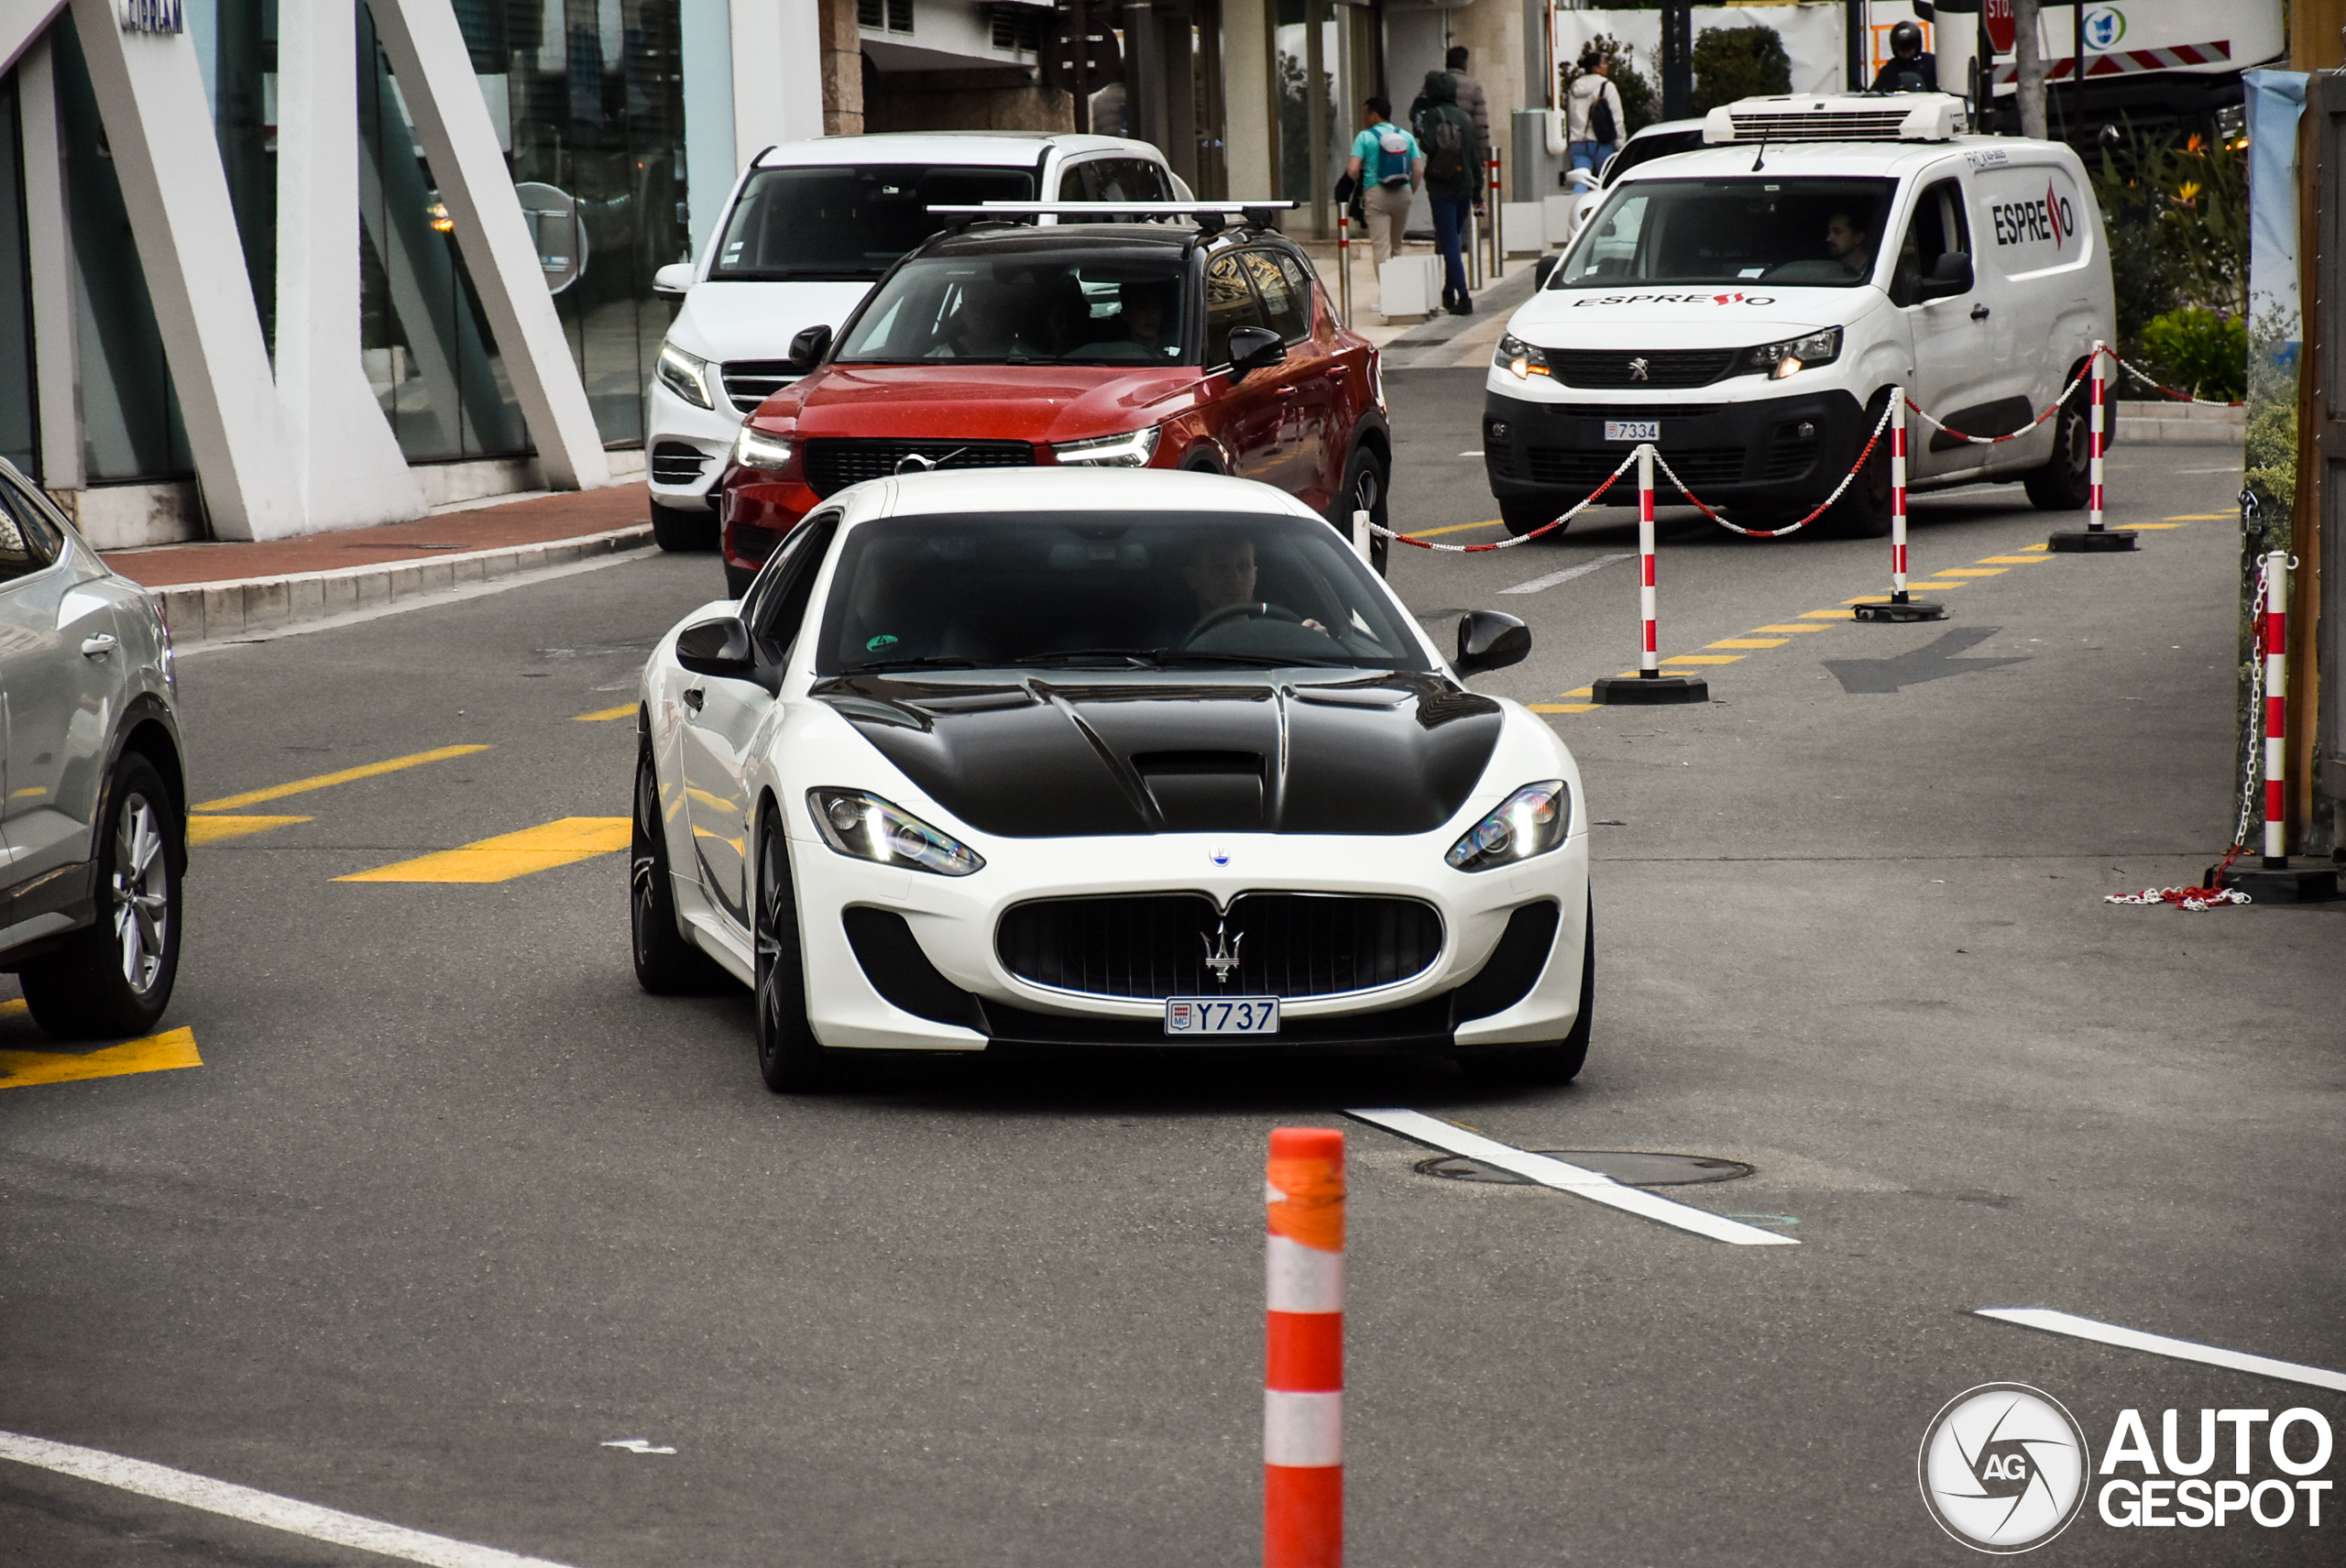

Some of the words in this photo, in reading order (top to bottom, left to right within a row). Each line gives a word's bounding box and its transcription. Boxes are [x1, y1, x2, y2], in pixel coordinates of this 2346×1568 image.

[1618, 423, 1656, 438] 7334
[1175, 1017, 1188, 1025] MC
[1196, 1003, 1274, 1030] Y737
